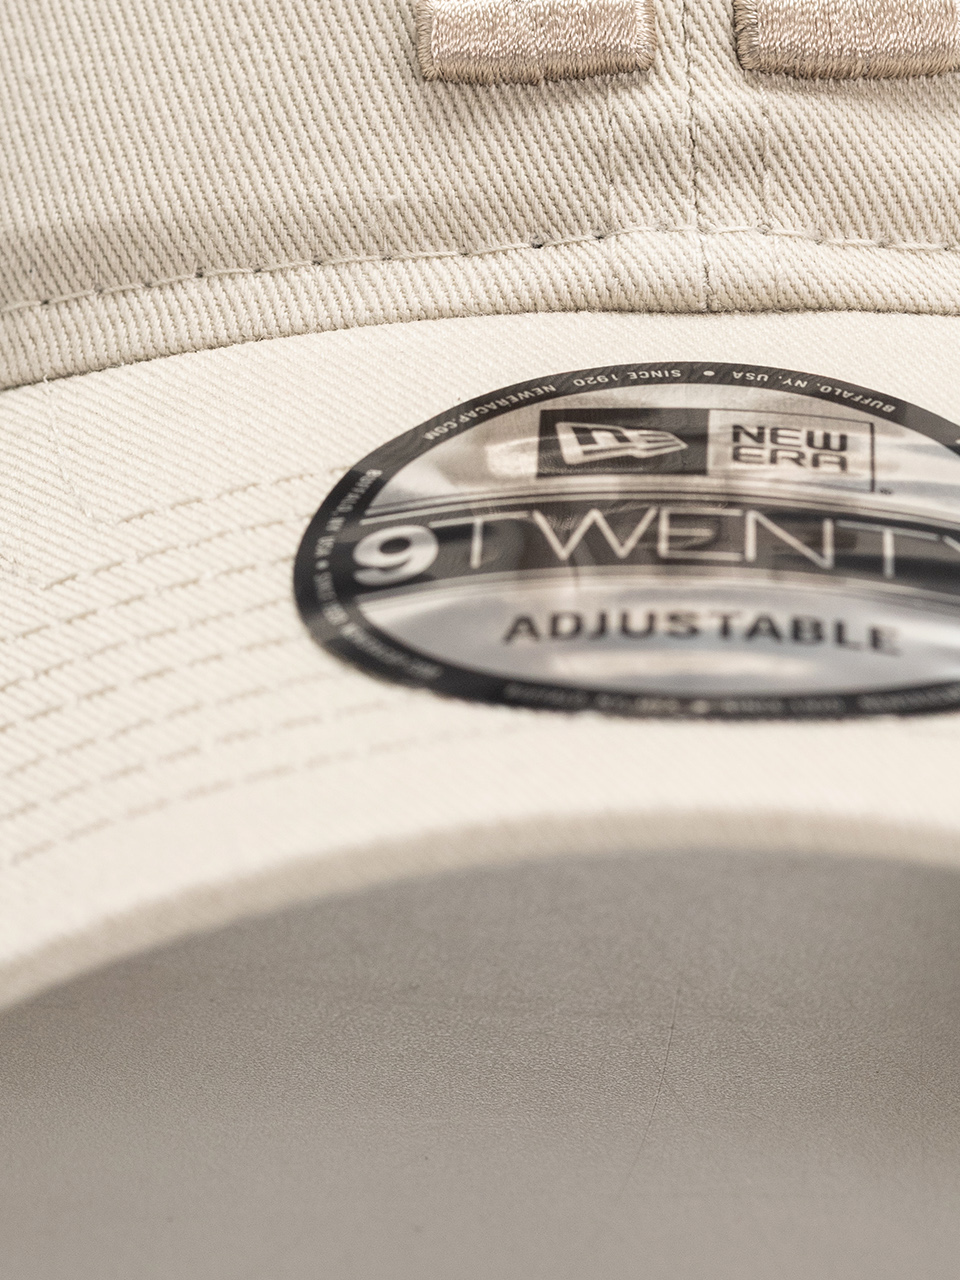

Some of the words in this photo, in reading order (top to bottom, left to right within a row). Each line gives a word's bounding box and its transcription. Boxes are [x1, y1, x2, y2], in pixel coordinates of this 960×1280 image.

[572, 373, 619, 387] 1920
[627, 369, 683, 380] SINCE
[732, 371, 768, 382] USA
[422, 383, 558, 441] NEWERACAP.COM
[732, 424, 848, 452] NEW
[732, 445, 848, 474] ERA
[352, 505, 960, 587] 9TWENT
[502, 610, 902, 657] ADJUSTABLE
